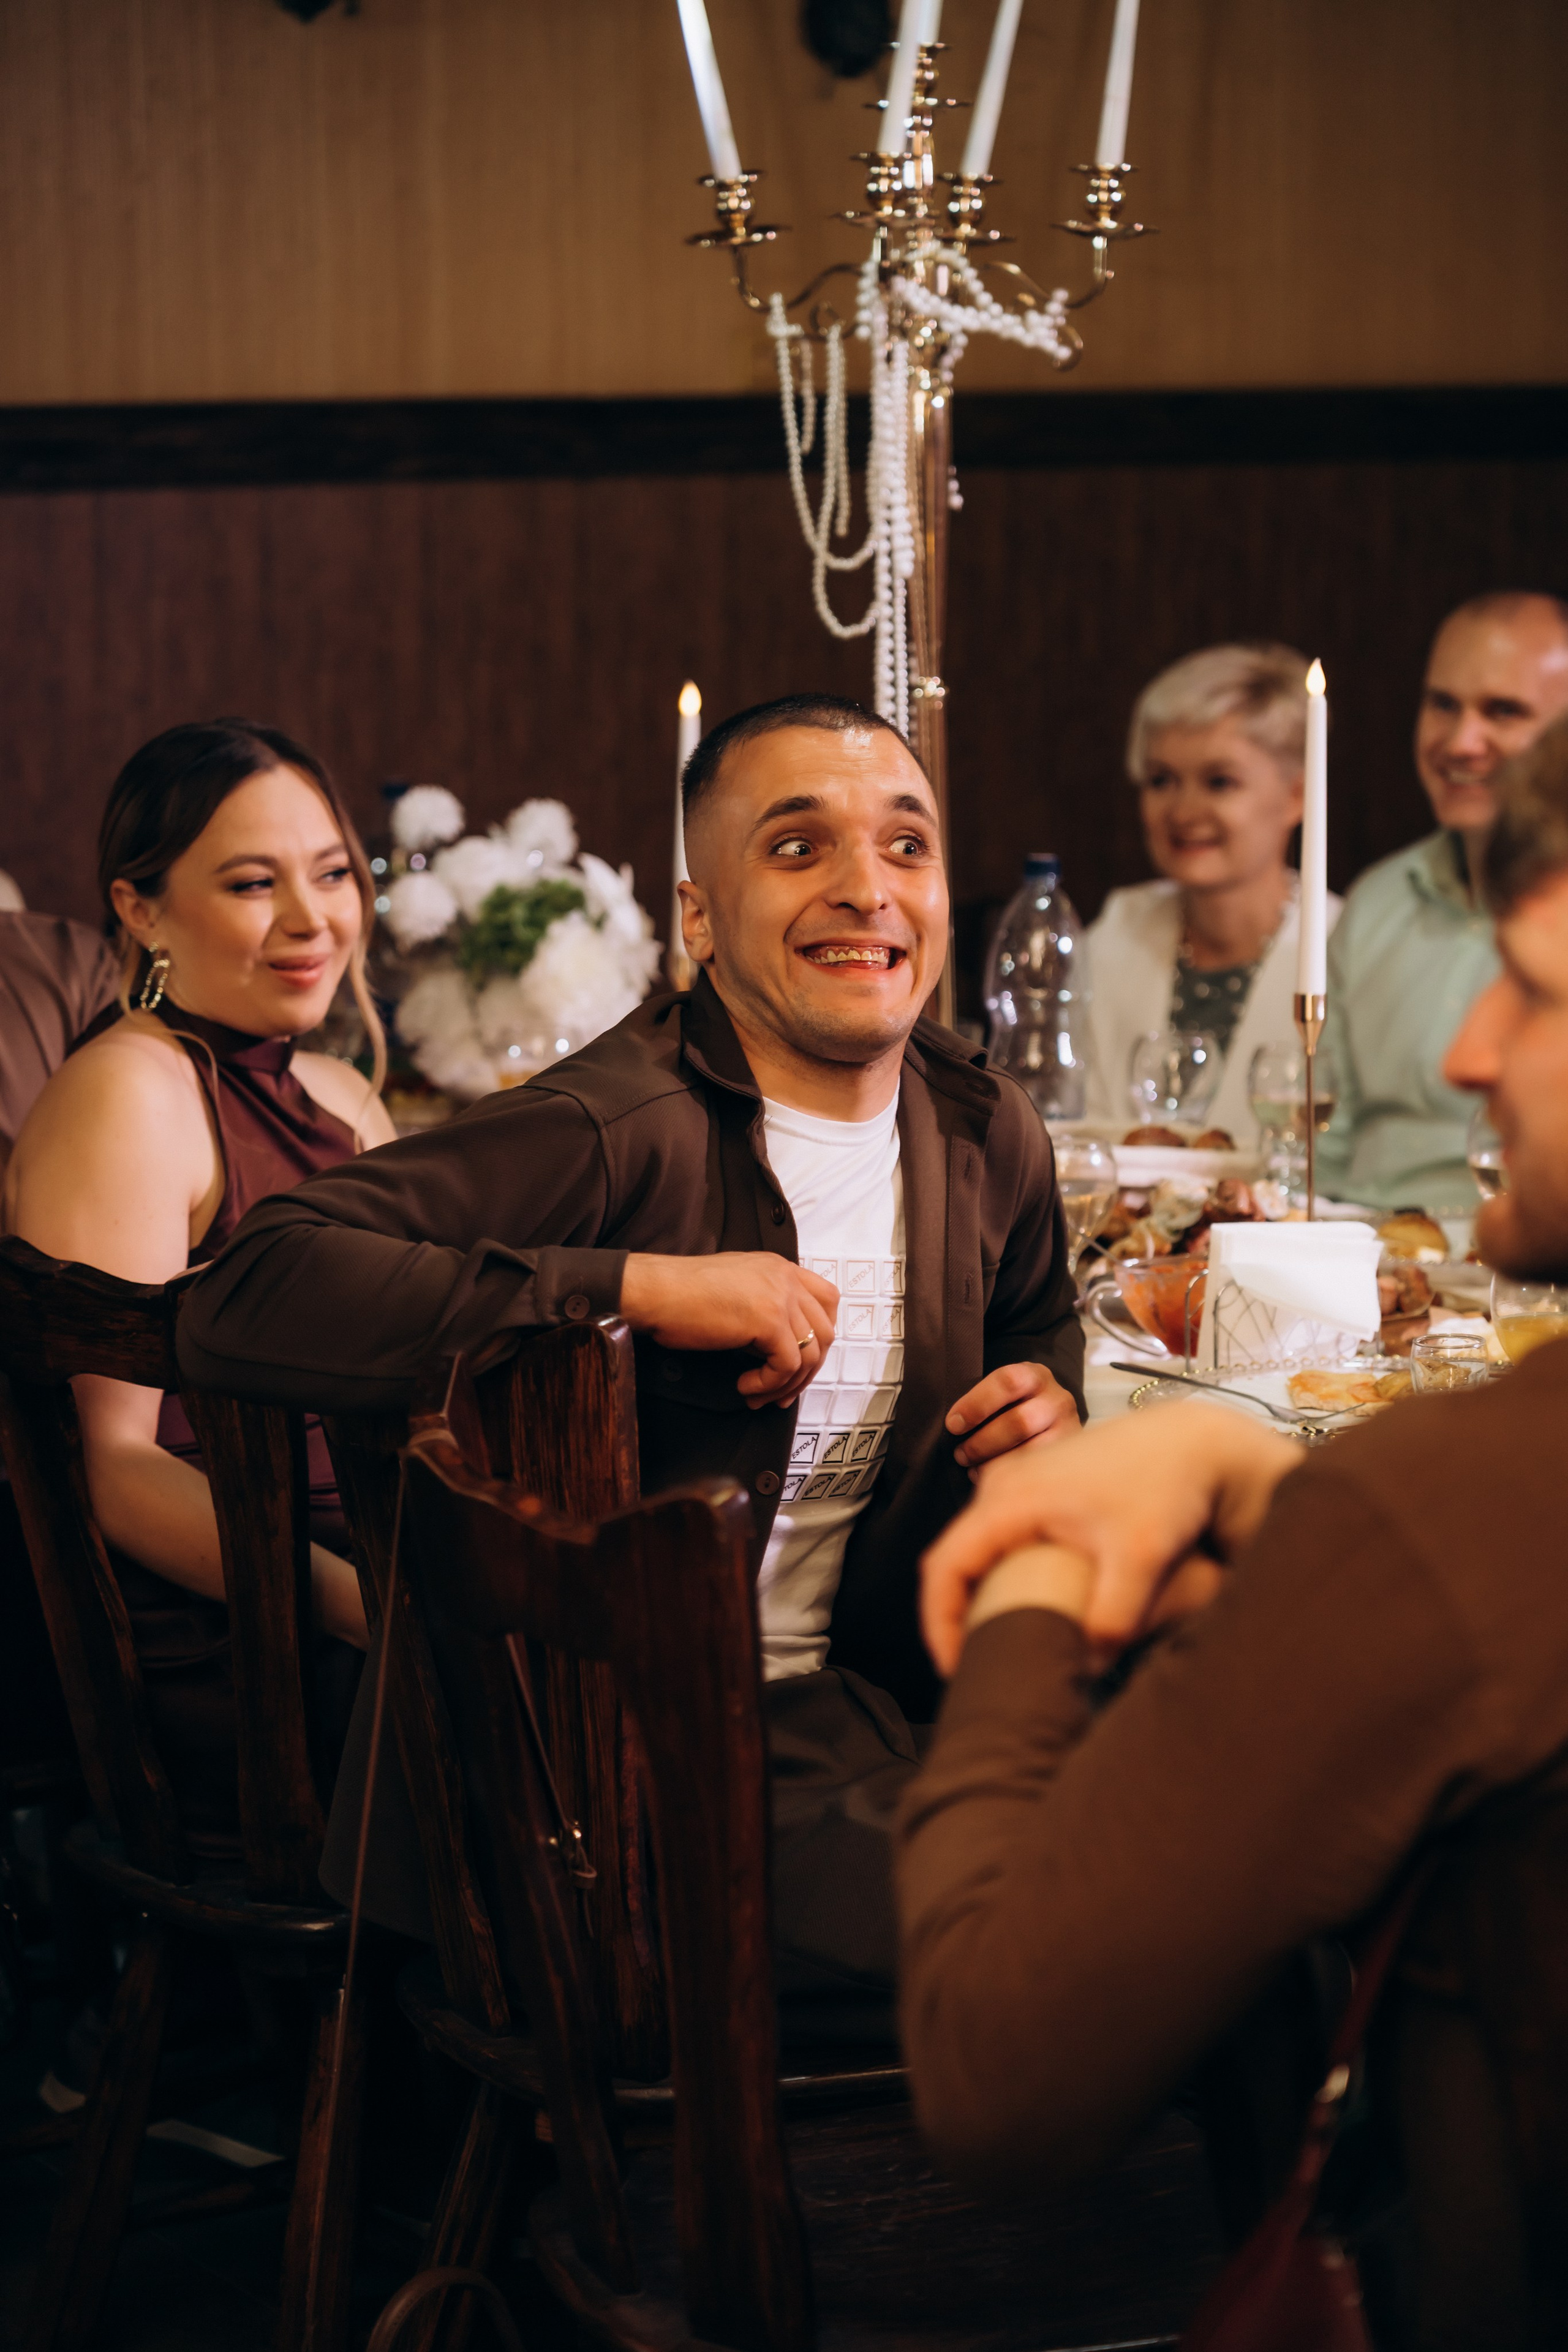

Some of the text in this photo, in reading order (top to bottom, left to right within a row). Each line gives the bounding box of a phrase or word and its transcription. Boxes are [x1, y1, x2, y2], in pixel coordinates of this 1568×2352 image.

[820, 1264, 836, 1278] TOLA
[848, 1264, 873, 1287] ESTOLA
[848, 1308, 872, 1332] ESTOLA
[791, 1436, 816, 1459] ESTOLA
[824, 1436, 848, 1459] ESTOLA
[852, 1434, 874, 1457] ESTOLA
[783, 1477, 803, 1491] TOLA
[804, 1476, 832, 1496] ESTOLA
[832, 1473, 858, 1493] ESTOLA
